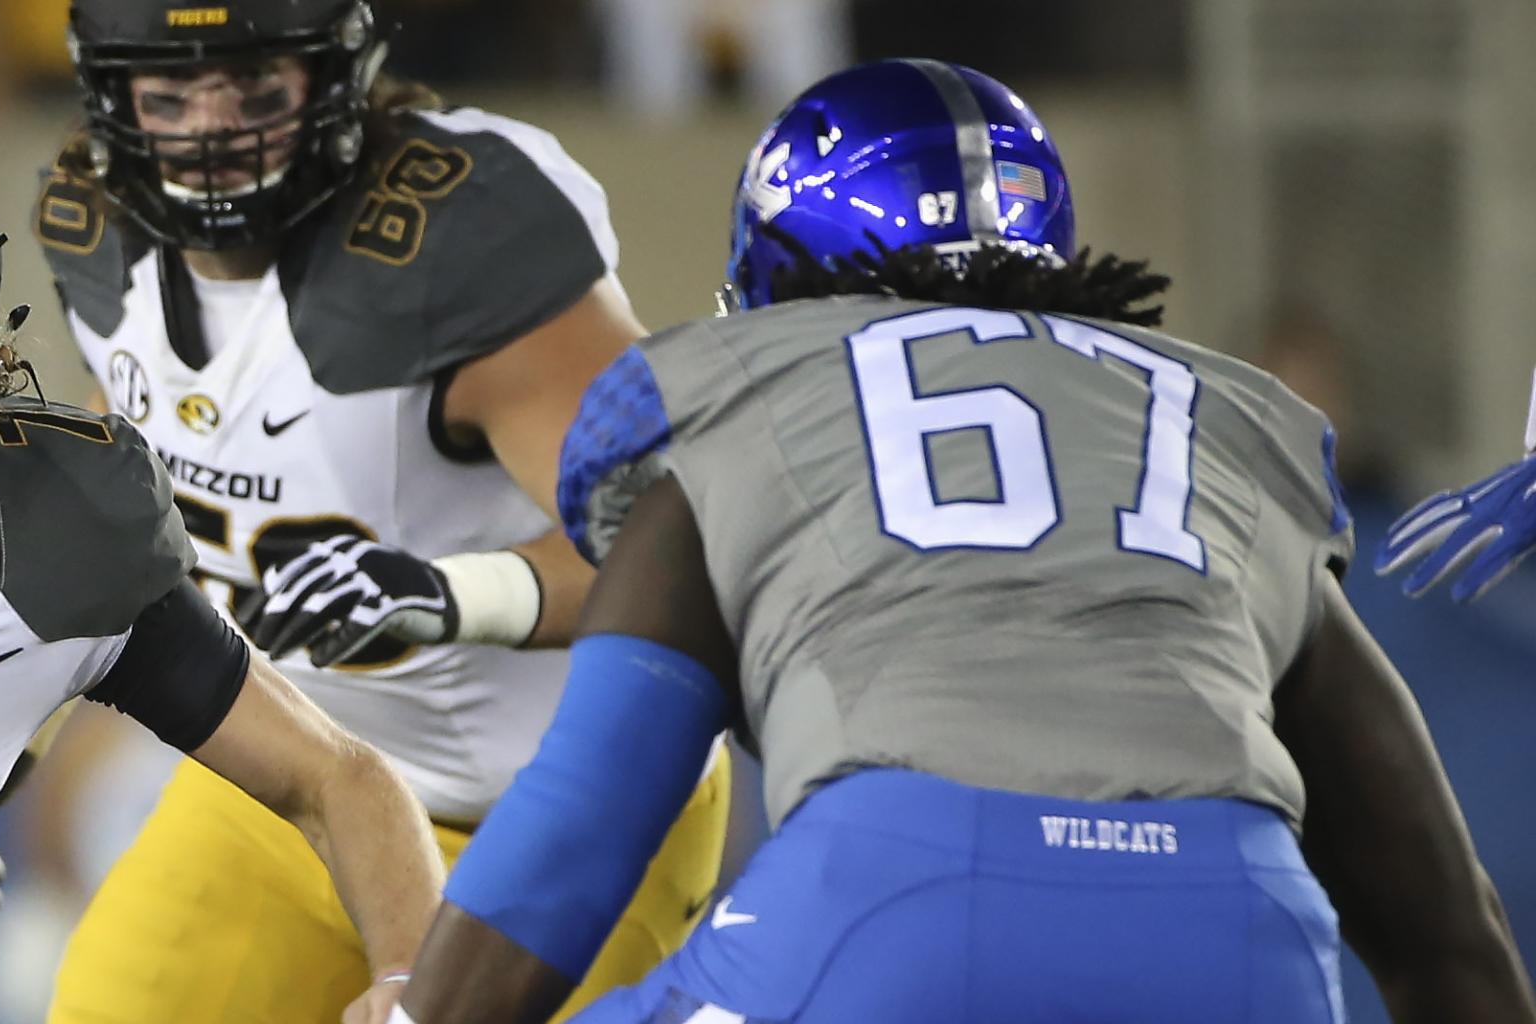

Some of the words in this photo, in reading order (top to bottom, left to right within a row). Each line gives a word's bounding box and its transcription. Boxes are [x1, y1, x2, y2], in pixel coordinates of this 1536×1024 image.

[918, 191, 957, 226] 67
[843, 305, 1206, 576] 67
[1039, 815, 1178, 854] WILDCATS
